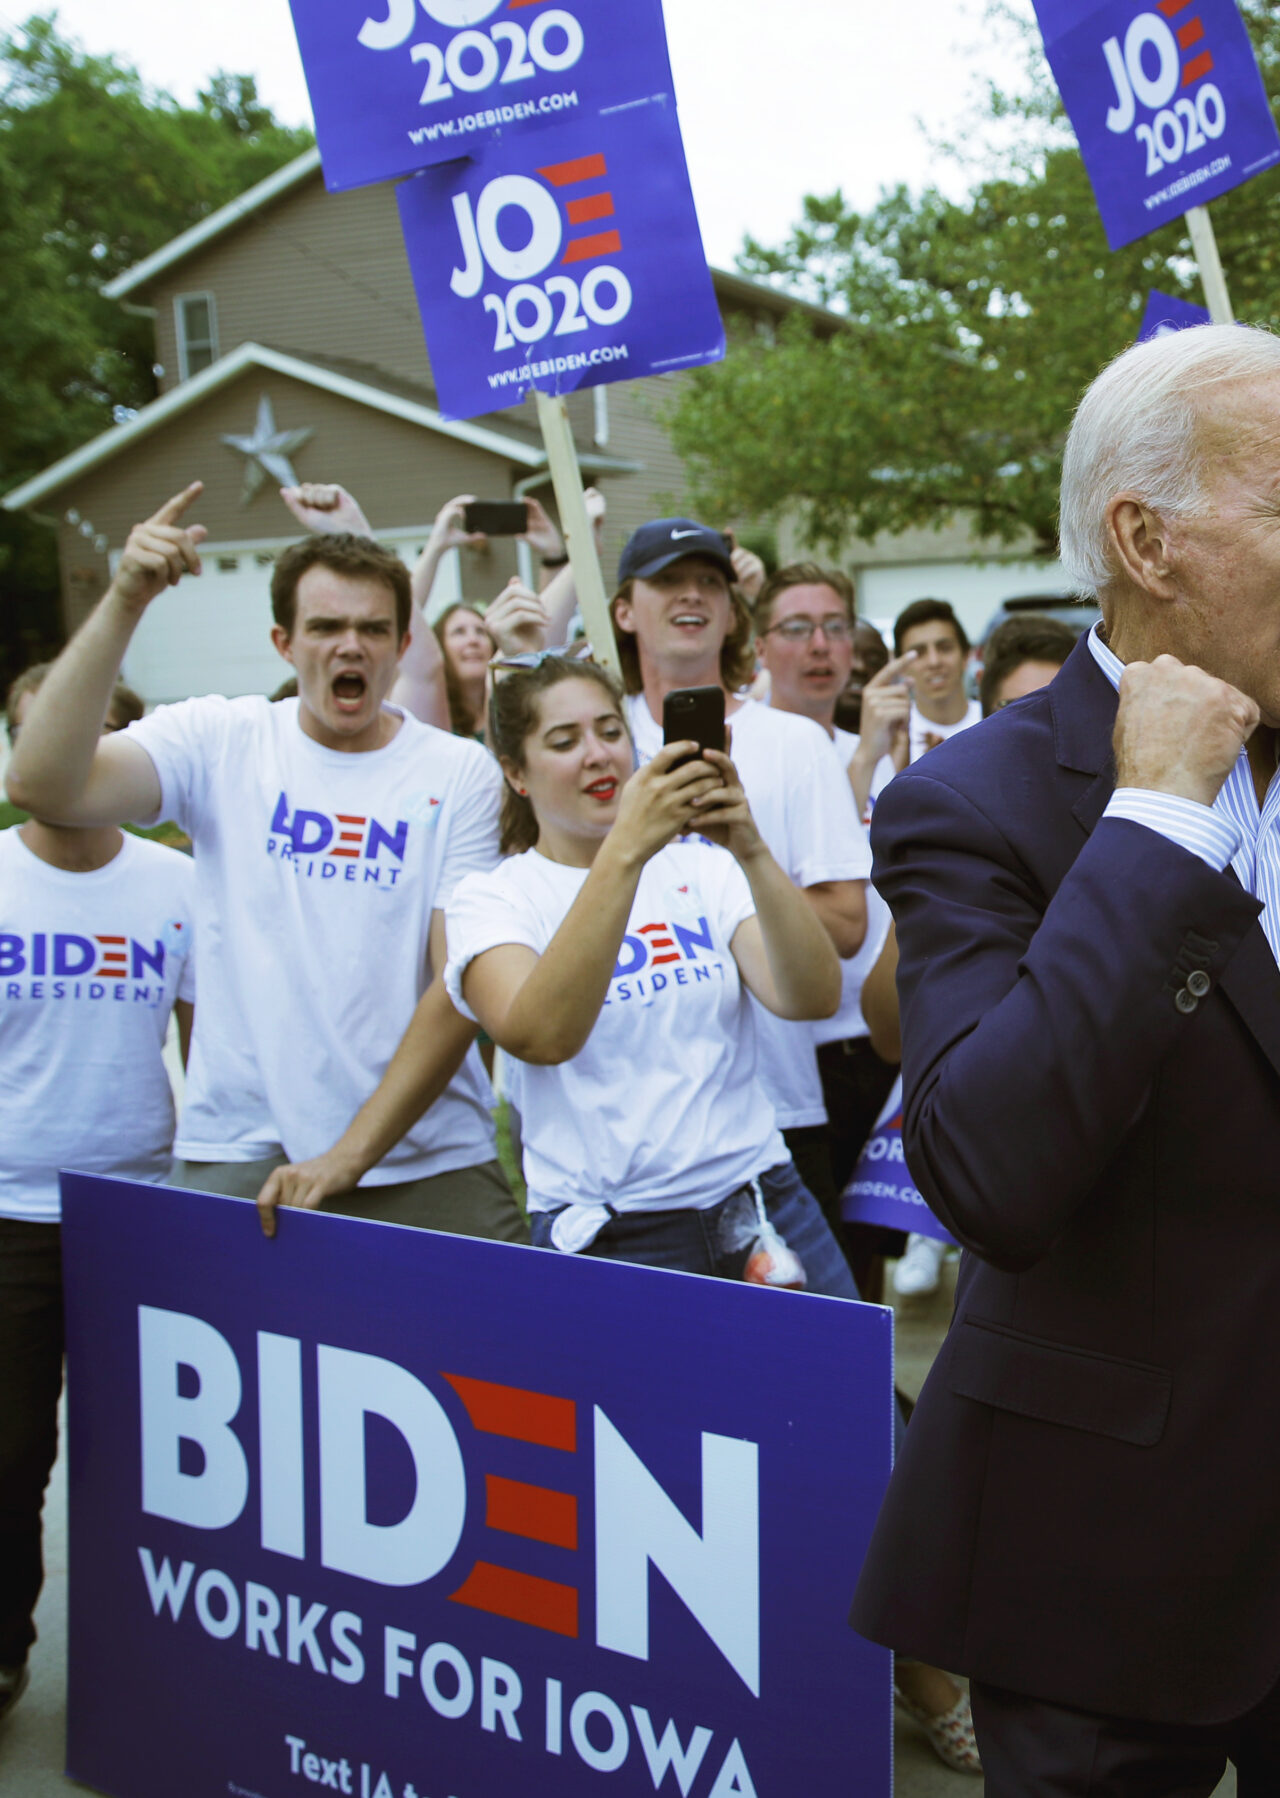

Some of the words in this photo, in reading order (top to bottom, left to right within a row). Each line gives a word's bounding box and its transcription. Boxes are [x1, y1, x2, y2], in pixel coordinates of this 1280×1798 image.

[410, 8, 584, 105] 2020
[1102, 0, 1214, 133] JOE
[408, 91, 578, 144] WWW.JOEBIDEN.COM
[1136, 83, 1226, 177] 2020
[450, 153, 622, 298] JOE
[483, 265, 632, 352] 2020
[488, 345, 629, 388] WWW.JOEBIDEN.COM
[0, 932, 165, 980] BIDEN
[7, 982, 164, 1002] RESIDENT
[138, 1304, 760, 1699] BIDEN
[137, 1546, 365, 1686] WORKS
[384, 1625, 522, 1742] FOR
[544, 1676, 760, 1798] IOWA
[284, 1733, 353, 1795] Text
